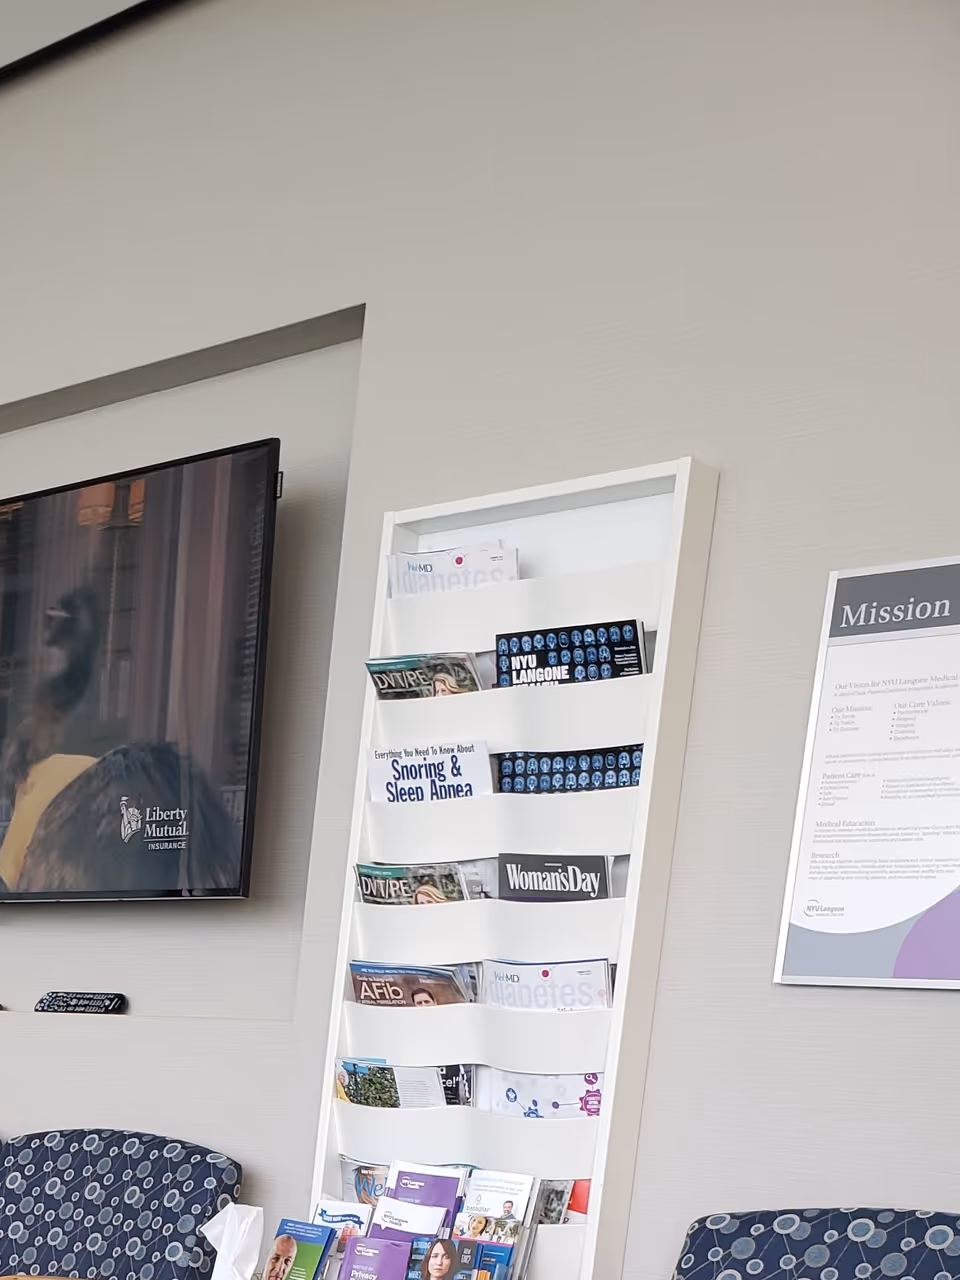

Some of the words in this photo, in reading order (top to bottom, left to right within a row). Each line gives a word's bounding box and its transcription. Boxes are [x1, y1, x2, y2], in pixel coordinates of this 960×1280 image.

[839, 596, 951, 628] Mission
[511, 654, 537, 670] NYU
[373, 669, 431, 689] DVT/PE
[511, 665, 570, 684] LANGONE
[374, 750, 403, 760] Everything
[403, 748, 414, 757] You
[414, 747, 430, 757] Need
[430, 746, 438, 755] To
[439, 745, 455, 754] Know
[456, 743, 475, 753] About
[391, 757, 446, 782] Snoring
[450, 754, 462, 777] &
[385, 781, 424, 803] Sleep
[430, 778, 473, 801] Apnea
[145, 806, 188, 823] Liberty
[148, 841, 187, 851] INSURANCE
[360, 876, 412, 899] DVT/PE
[360, 981, 404, 1000] AFib
[354, 1173, 388, 1197] We
